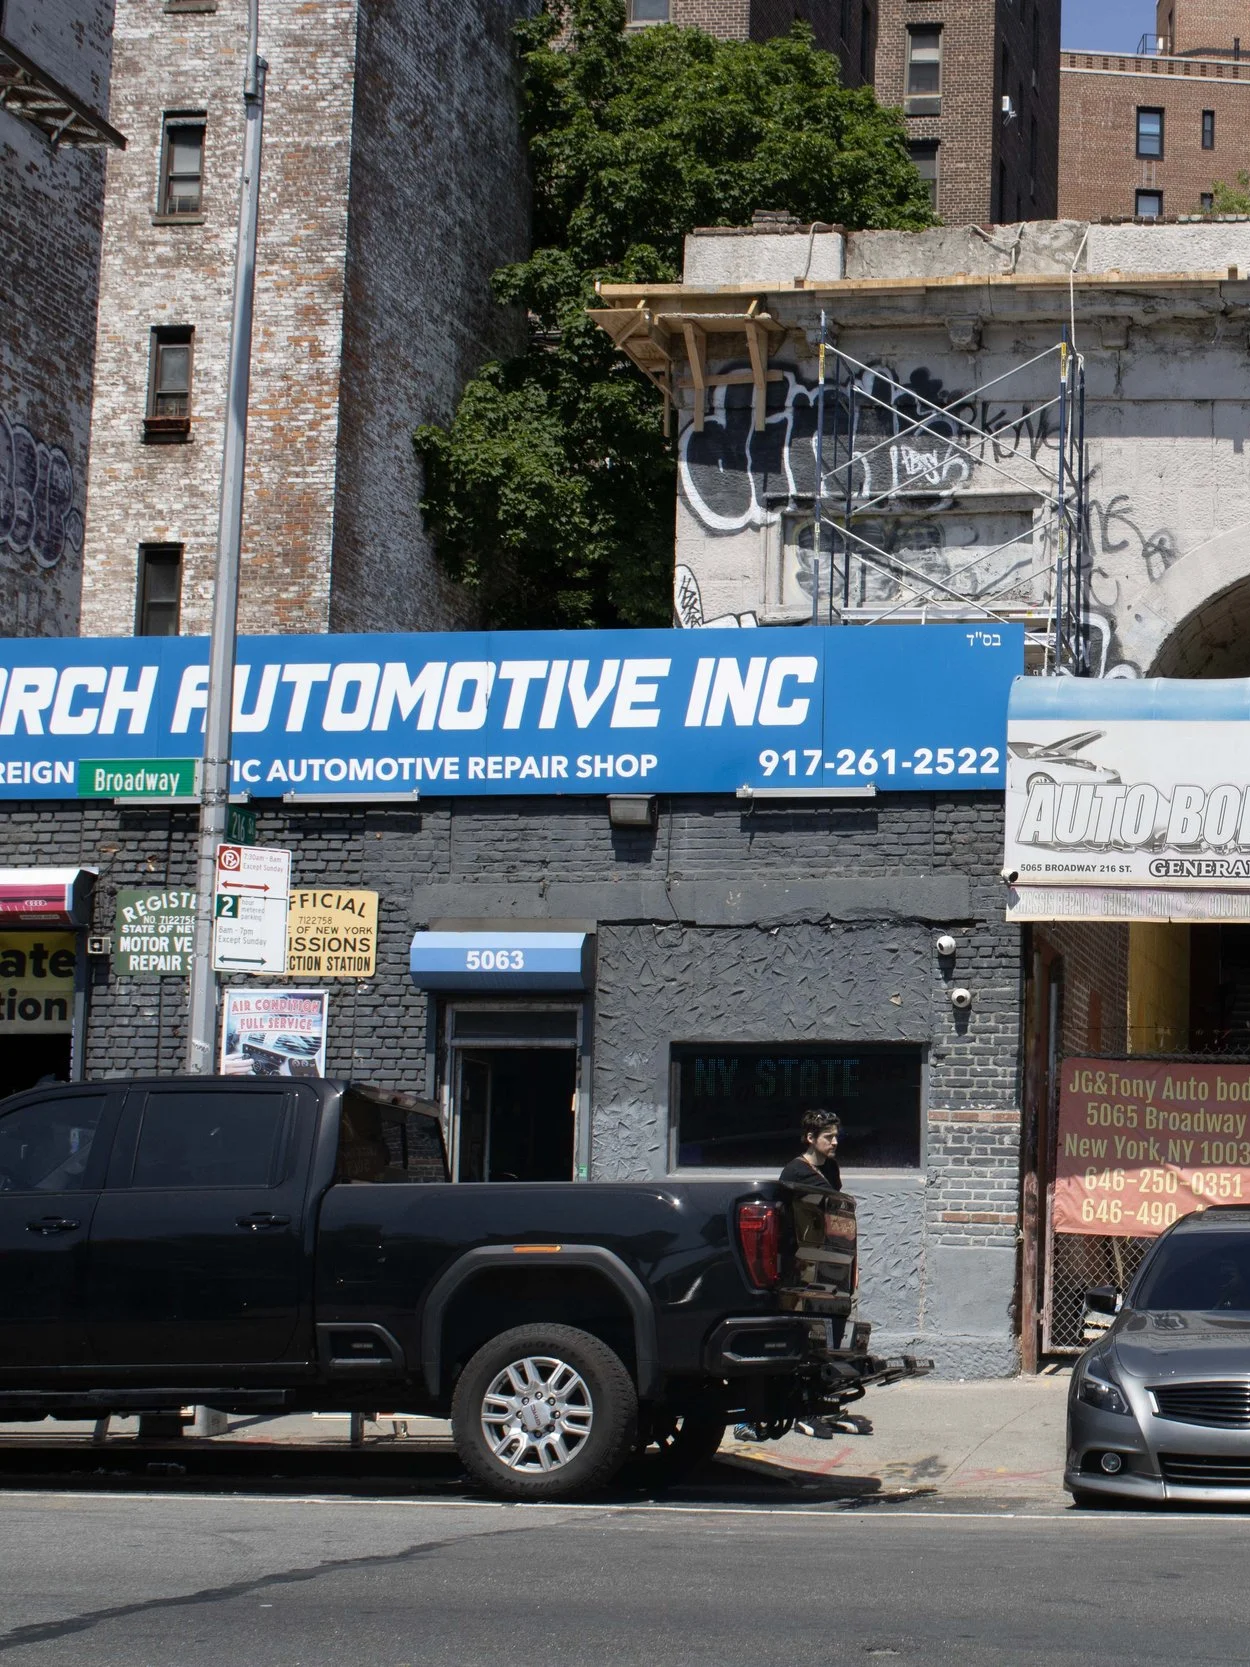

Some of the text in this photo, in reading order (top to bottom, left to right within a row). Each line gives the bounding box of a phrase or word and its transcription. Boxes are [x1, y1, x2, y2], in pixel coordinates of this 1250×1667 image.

[966, 631, 1002, 646] בס"ד
[0, 656, 818, 735] RCH AUTOMOTIVE INC
[266, 756, 460, 783] AUTOMOTIVE
[469, 755, 568, 780] REPAIR
[576, 754, 658, 778] SHOP
[758, 747, 1000, 777] 917-261-2522
[94, 768, 180, 796] Broadway
[1016, 783, 1160, 845] AUTO
[231, 811, 246, 842] 216
[243, 863, 283, 873] Except Sunday
[1020, 863, 1133, 873] 5065 BROADWAY 216 ST.
[121, 892, 196, 922] REGISTE
[221, 895, 234, 917] 2
[289, 893, 366, 918] FFICIAL
[1057, 892, 1091, 916] REPAIR
[1100, 892, 1143, 917] GENERAL
[1147, 893, 1175, 917] PAINT
[1208, 894, 1242, 918] COLOR
[121, 925, 154, 933] STATE
[158, 925, 172, 933] OF
[218, 926, 234, 934] 8am
[240, 927, 254, 936] 7pm
[296, 927, 311, 935] OF
[316, 927, 339, 935] NEW
[344, 927, 373, 935] YORK
[298, 916, 333, 925] 7122758
[119, 936, 169, 952] MOTOR
[218, 935, 267, 947] Except Sunday
[289, 938, 371, 953] ISSIONS
[129, 956, 181, 971] REPAIR
[287, 956, 371, 972] CTION STATION
[466, 950, 524, 971] 5063
[231, 999, 319, 1012] AIR CONDITION
[240, 1018, 312, 1030] FULL SERVICE
[695, 1058, 860, 1097] NY STATE
[1069, 1069, 1156, 1102] JG&Tony
[1162, 1075, 1209, 1102] Auto
[1086, 1101, 1247, 1140] 5065 Broadway
[1064, 1133, 1108, 1159] New
[1113, 1134, 1194, 1165] York,NY
[1084, 1166, 1243, 1198] 646-250-0351
[1081, 1199, 1203, 1227] 646-490-
